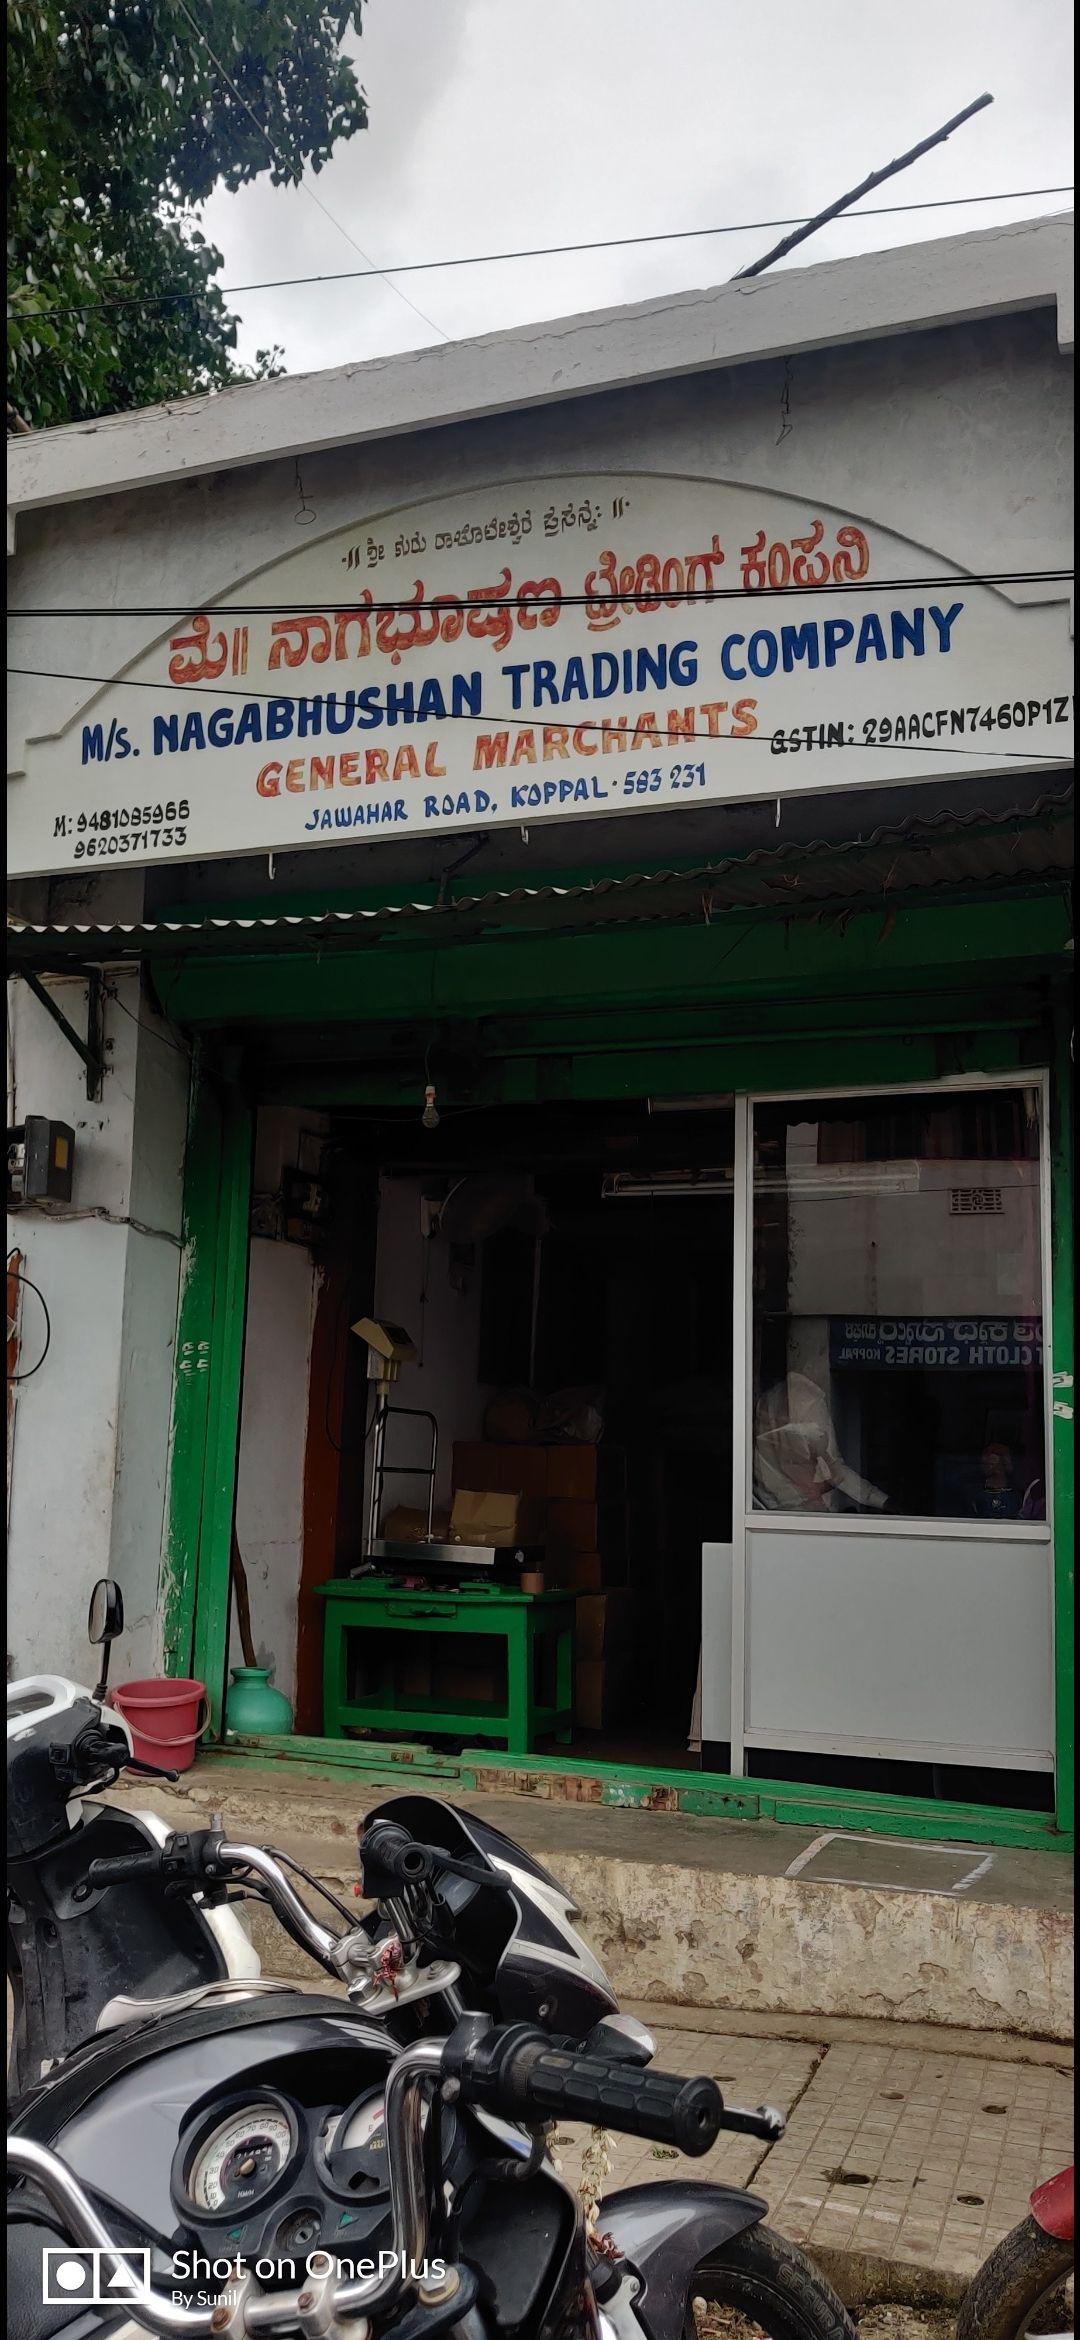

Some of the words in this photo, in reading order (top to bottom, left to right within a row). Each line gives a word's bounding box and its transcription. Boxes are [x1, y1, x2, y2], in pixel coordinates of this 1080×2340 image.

[153, 670, 484, 757] NAGABHUSHAN
[502, 638, 699, 709] TRADING
[720, 602, 965, 682] COMPANY
[255, 741, 447, 798] GENERAL
[472, 697, 759, 772] MARCHANTS
[770, 720, 856, 755] GSTIN:
[862, 696, 1074, 745] 29AACFN7460P1Z
[73, 826, 188, 860] 9620371733
[304, 798, 409, 831] JAWAHAR
